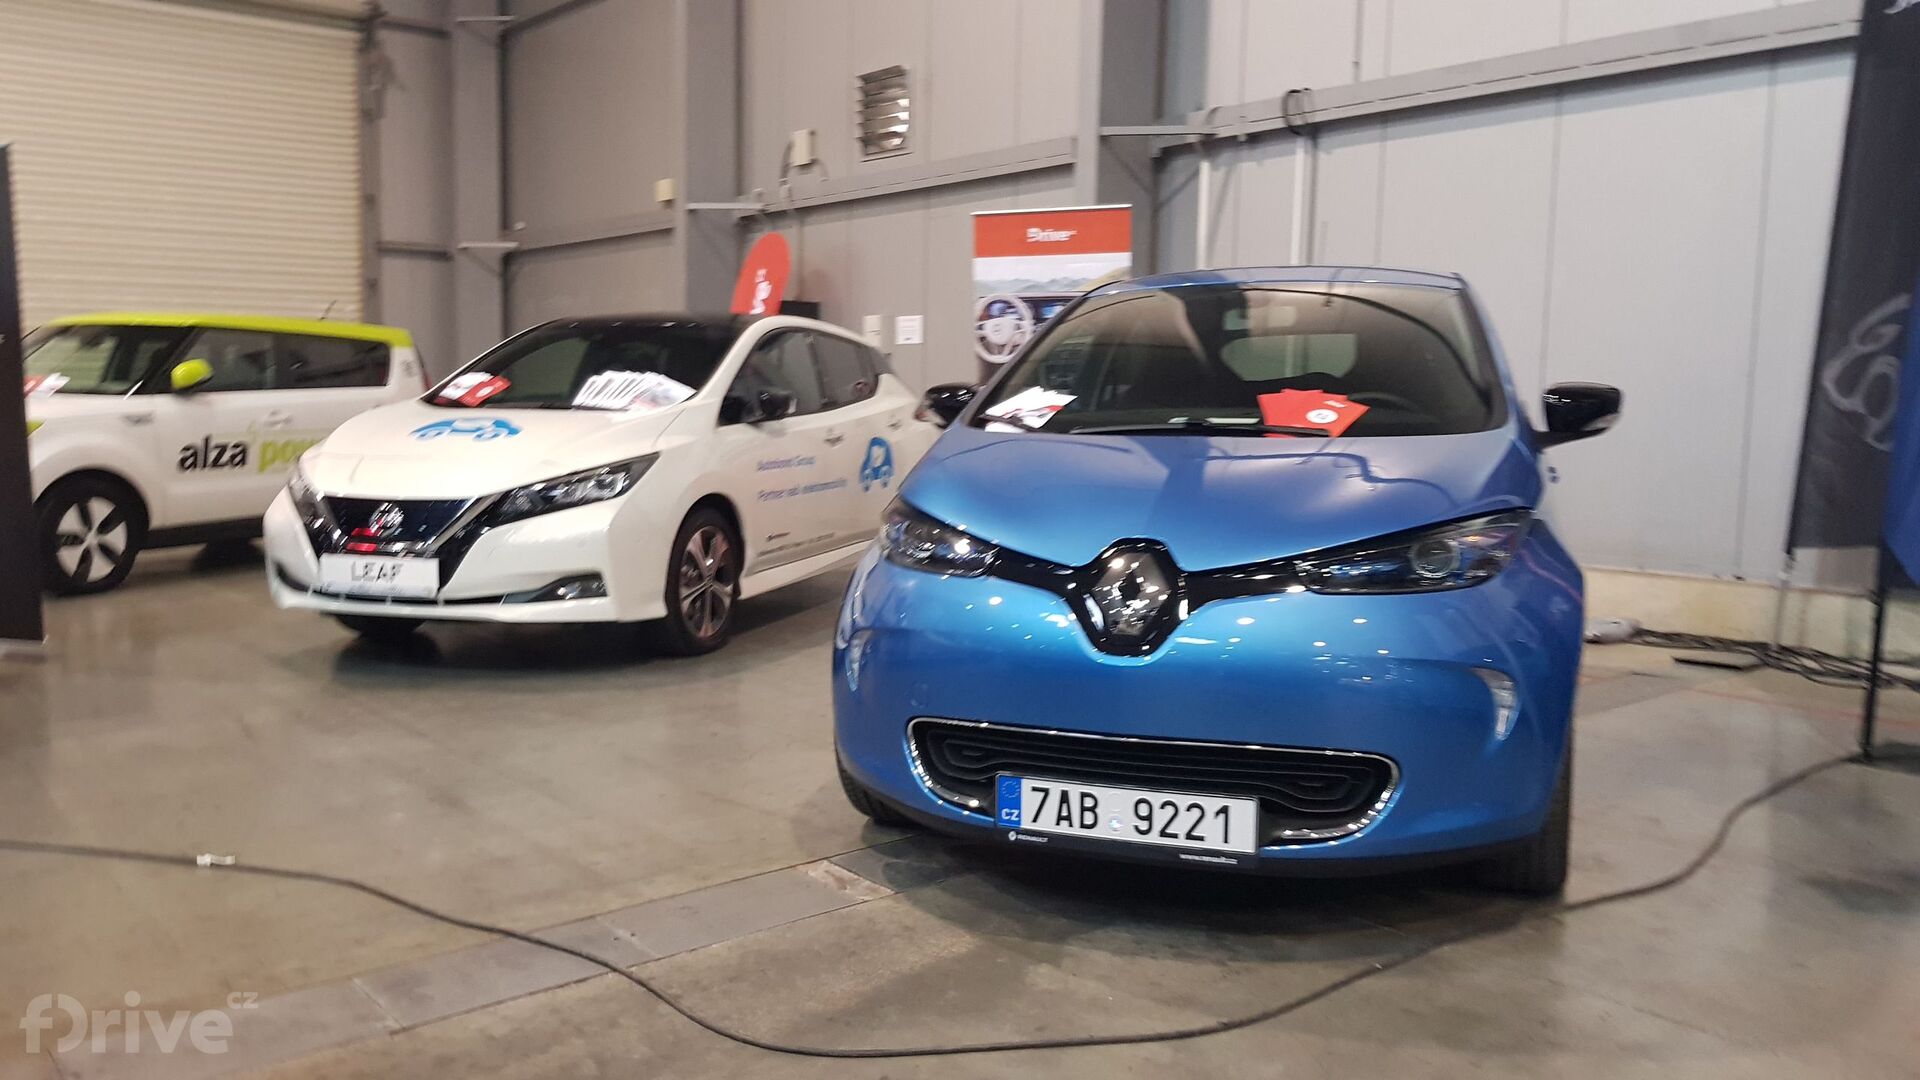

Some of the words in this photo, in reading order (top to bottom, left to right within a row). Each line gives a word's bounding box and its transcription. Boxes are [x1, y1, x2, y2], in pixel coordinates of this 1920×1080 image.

[178, 434, 249, 471] alza
[351, 561, 403, 582] LEAF
[1001, 808, 1019, 820] CZ
[1031, 786, 1098, 830] 7AB
[1133, 797, 1230, 844] 9221
